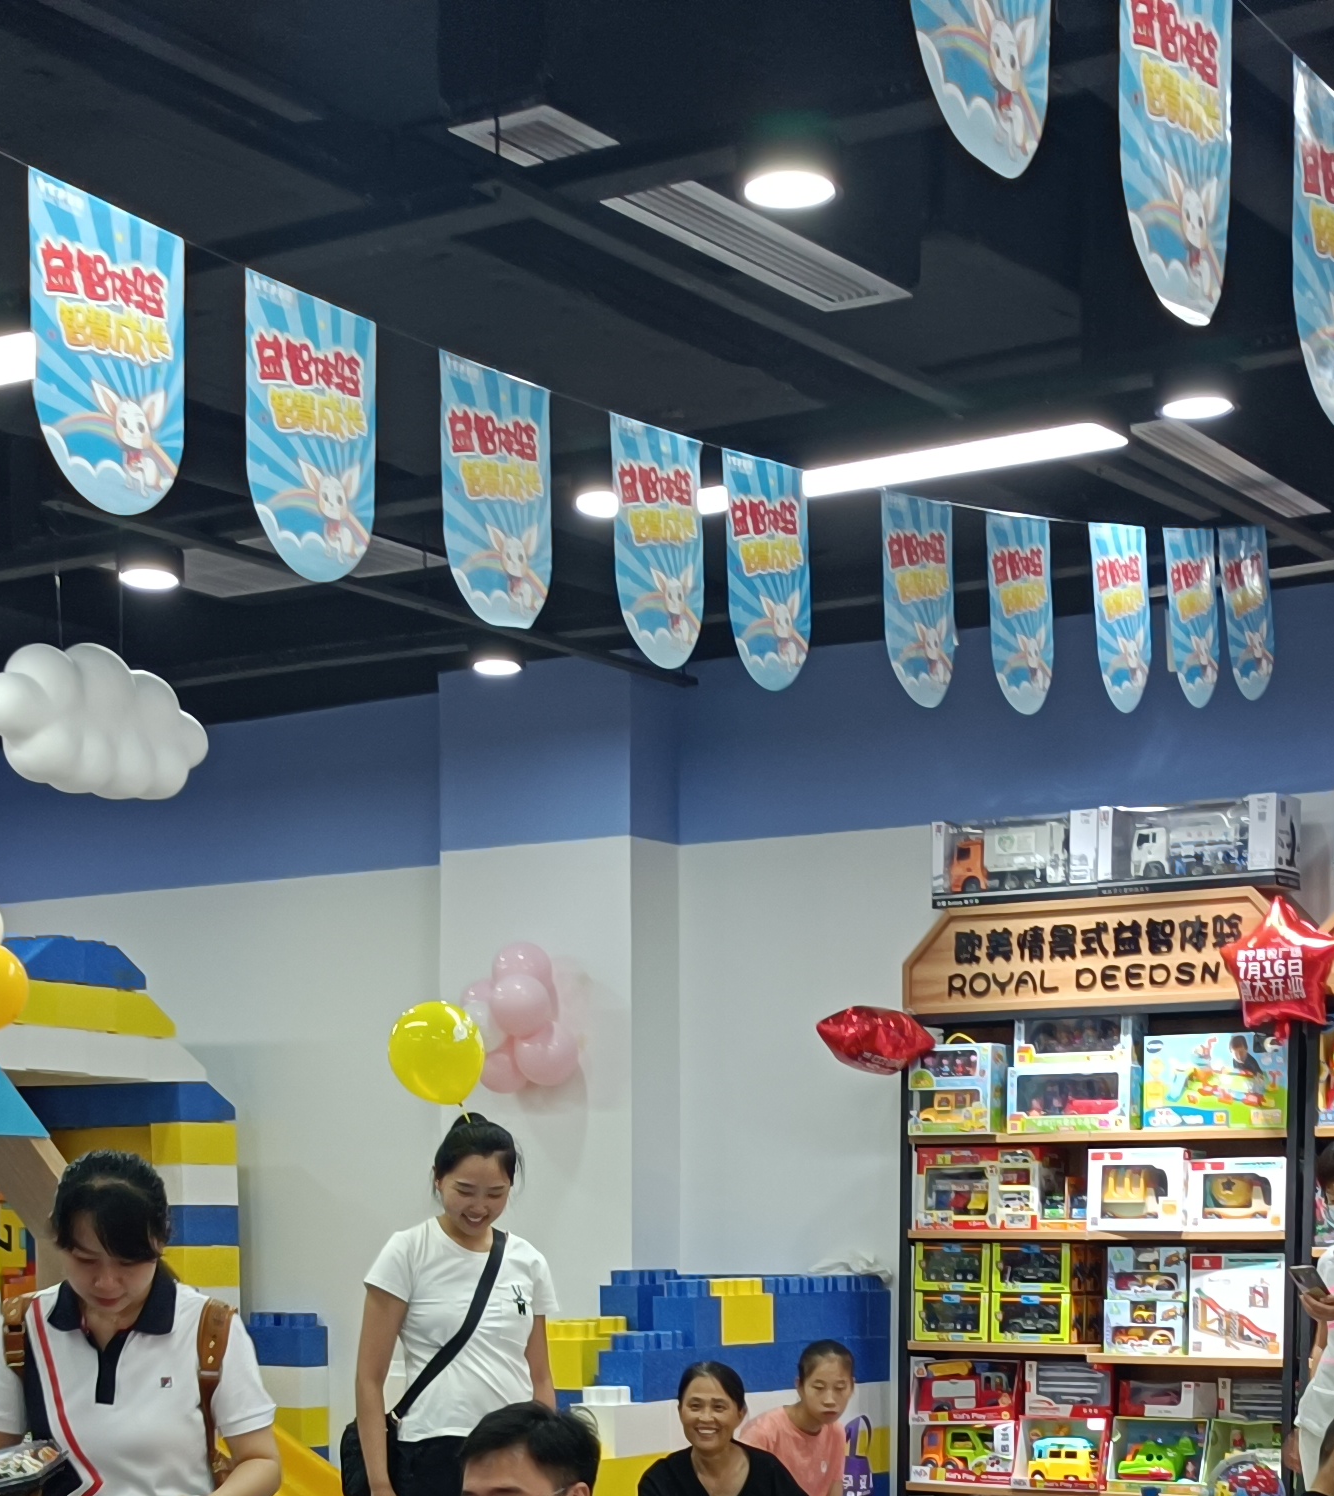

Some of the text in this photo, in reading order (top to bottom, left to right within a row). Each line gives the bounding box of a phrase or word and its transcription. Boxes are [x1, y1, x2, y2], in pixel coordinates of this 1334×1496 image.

[41, 239, 165, 318] 益智体验
[58, 302, 170, 364] 智慧成长
[255, 331, 362, 397] 益智体验
[954, 914, 1243, 966] 欧美情景式益智体验
[947, 961, 1221, 999] ROYAL DEEDSN
[1236, 959, 1303, 979] 7月16日
